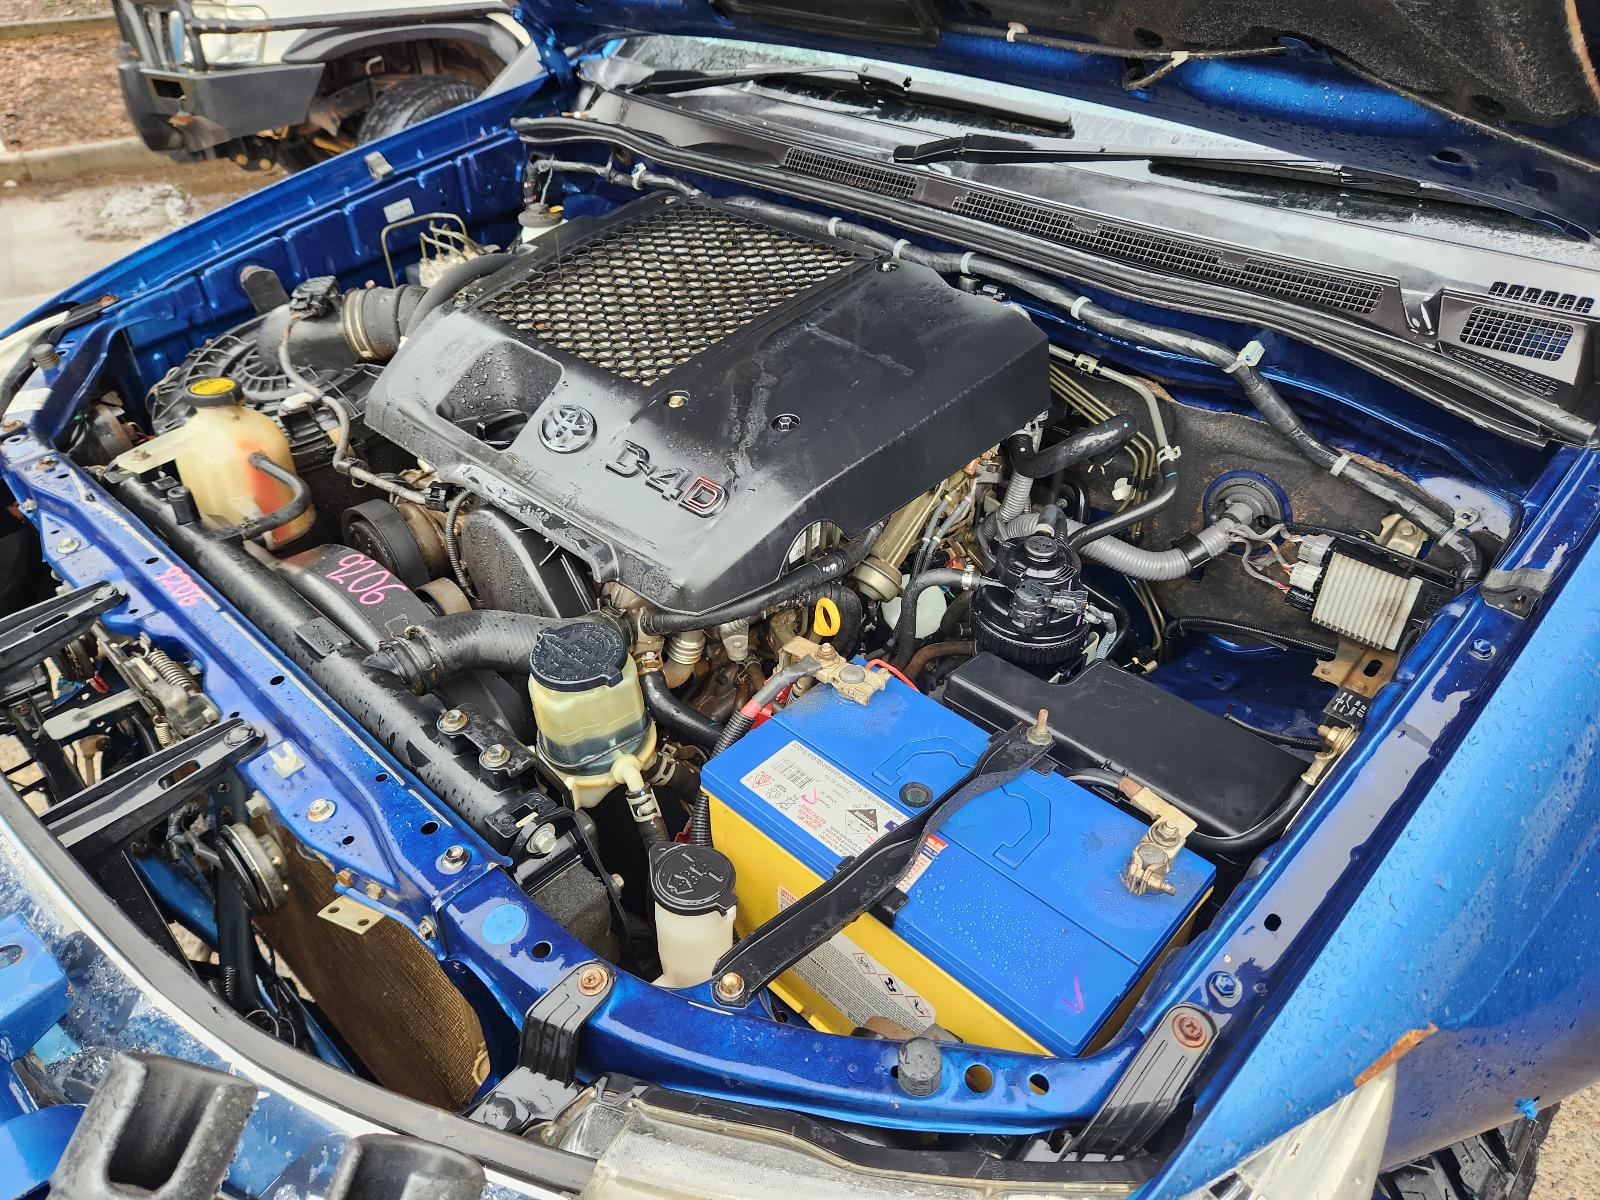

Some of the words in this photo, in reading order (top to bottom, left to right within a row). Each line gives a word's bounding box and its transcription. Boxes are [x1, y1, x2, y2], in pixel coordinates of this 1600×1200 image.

[605, 440, 730, 518] D-4D
[155, 566, 209, 607] 9206
[326, 553, 408, 605] 9206
